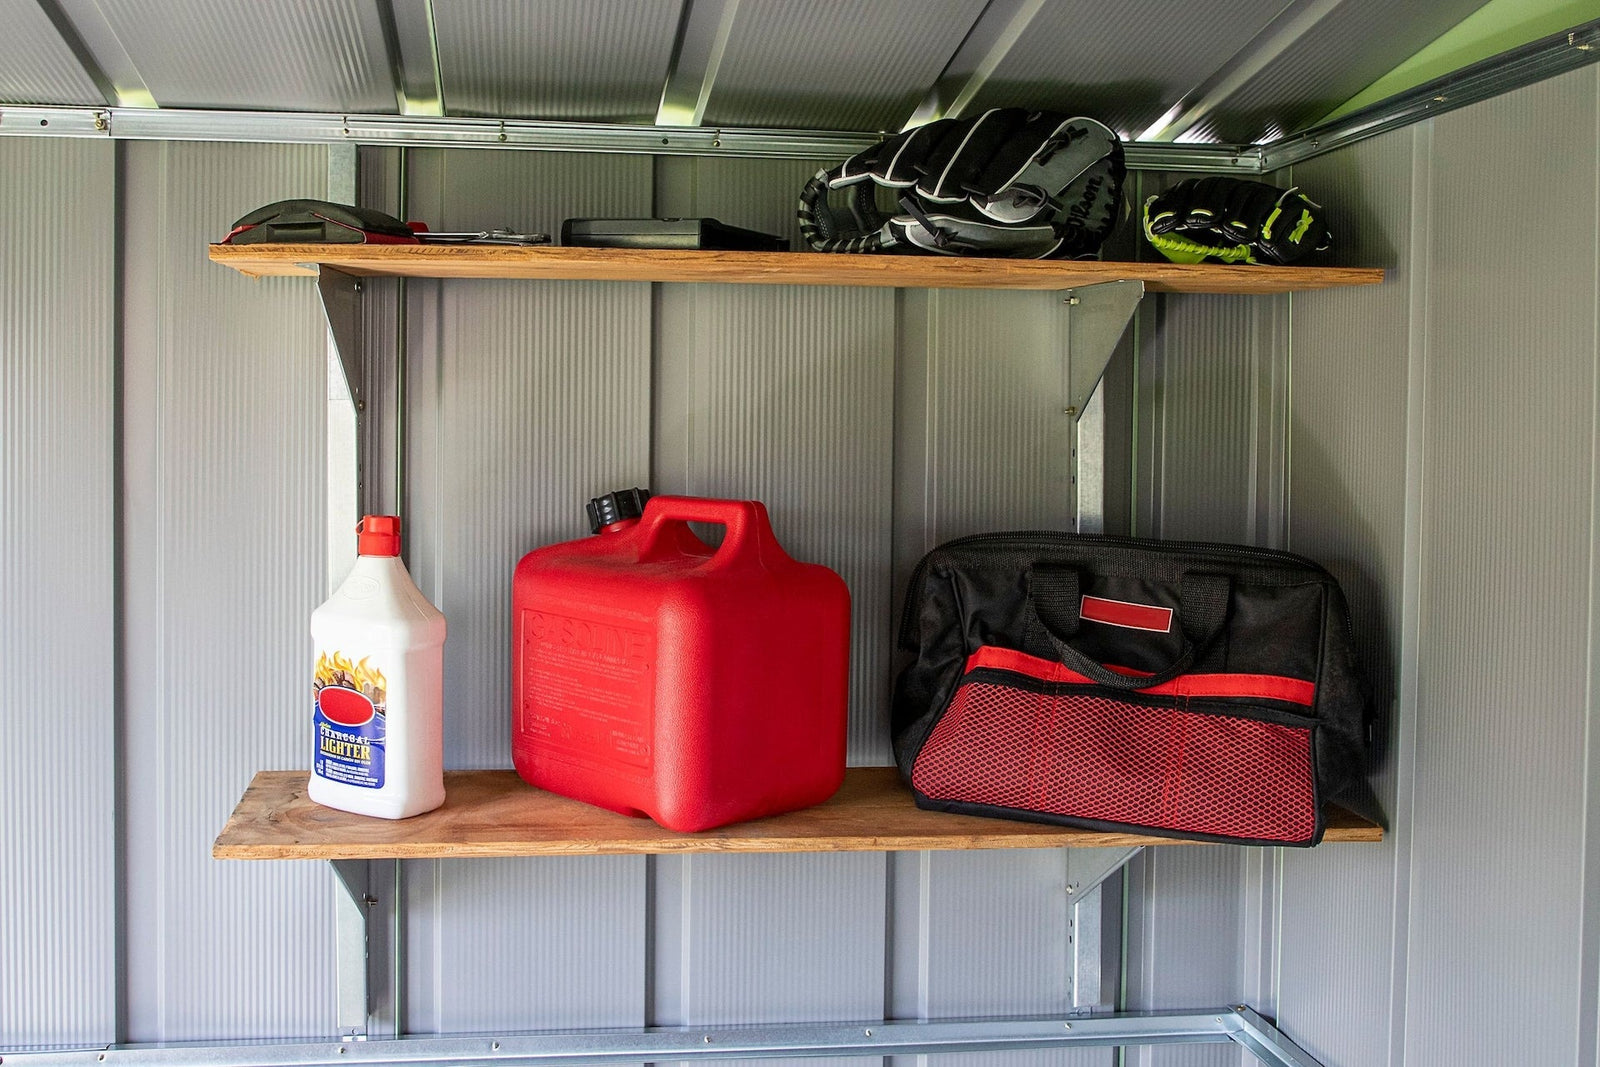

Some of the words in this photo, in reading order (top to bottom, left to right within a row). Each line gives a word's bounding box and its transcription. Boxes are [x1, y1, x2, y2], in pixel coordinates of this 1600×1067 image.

[529, 613, 646, 659] GASOLINE
[319, 727, 370, 745] CHARCOAL
[320, 736, 371, 760] LIGHTER
